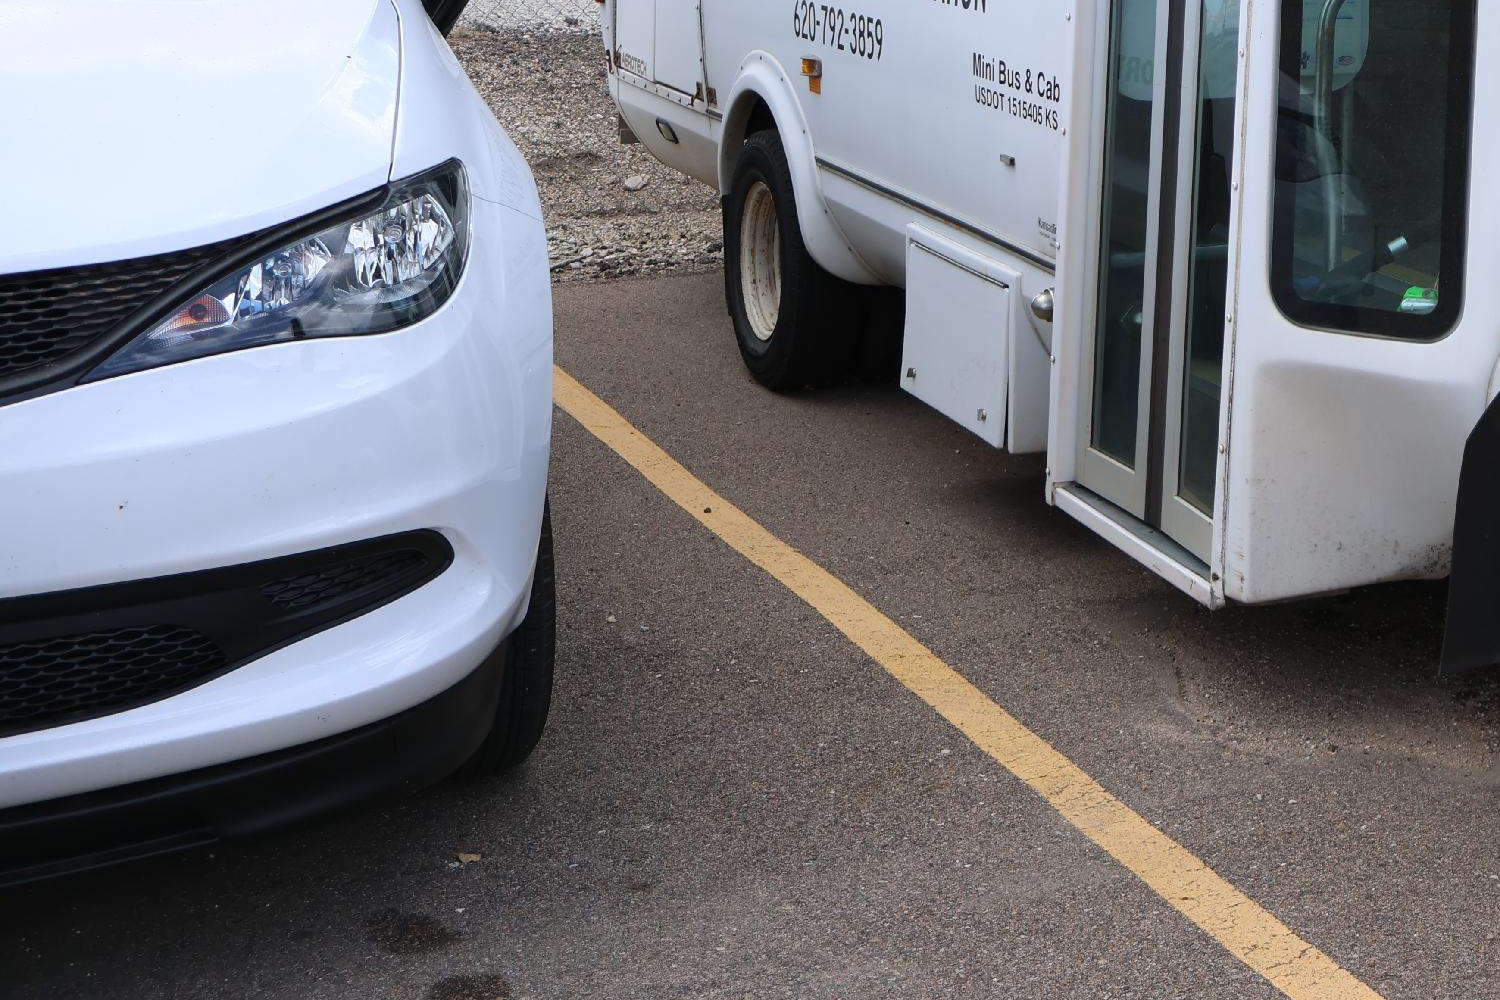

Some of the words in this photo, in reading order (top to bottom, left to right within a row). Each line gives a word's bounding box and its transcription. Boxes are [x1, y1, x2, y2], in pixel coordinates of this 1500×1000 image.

[972, 52, 995, 82] Mini
[999, 59, 1021, 91] Bus
[1024, 68, 1033, 94] &
[1037, 71, 1061, 103] Cab
[975, 83, 1005, 112] USDOT
[1007, 96, 1043, 125] 1515405
[1045, 107, 1059, 131] KS
